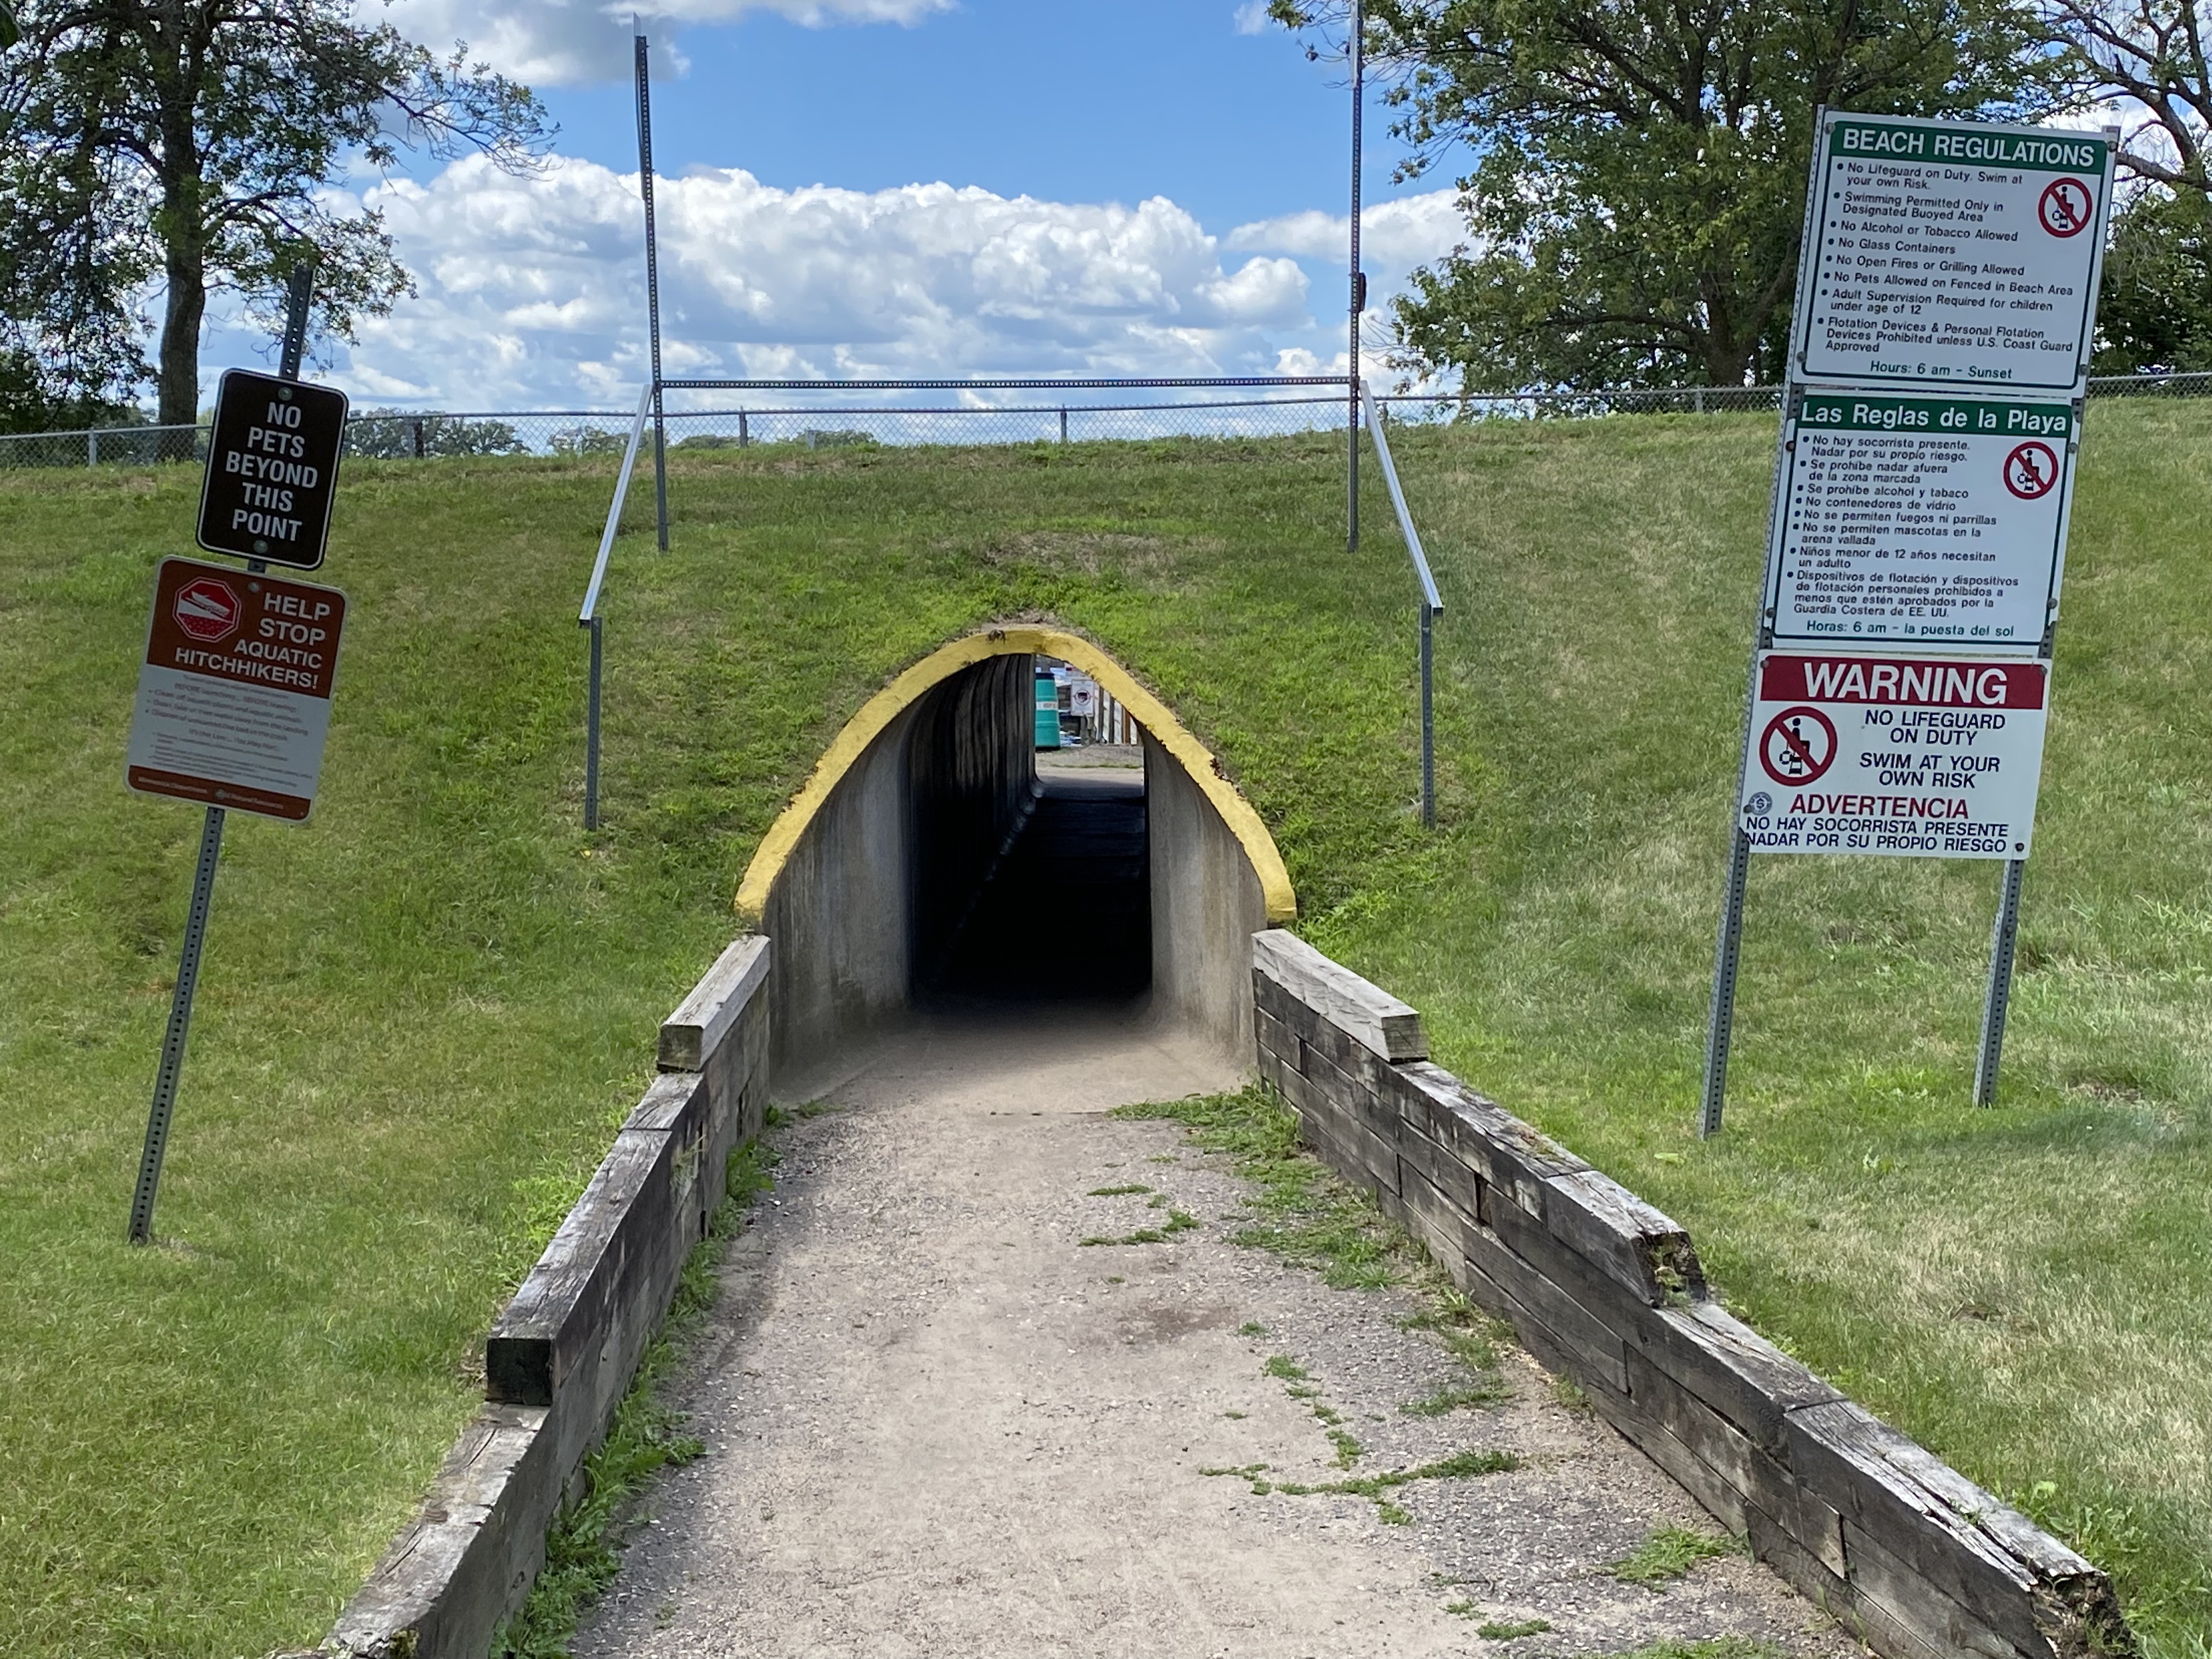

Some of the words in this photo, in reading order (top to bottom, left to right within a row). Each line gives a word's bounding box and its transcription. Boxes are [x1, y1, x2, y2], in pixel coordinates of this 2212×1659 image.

[1842, 128, 1925, 154] BEACH
[1933, 134, 2095, 167] REGULATIONS
[1846, 176, 1872, 187] your
[1876, 178, 1899, 188] own
[1847, 161, 1864, 173] No
[1867, 163, 1921, 178] Lifeguard
[1925, 170, 1940, 179] on
[1977, 171, 2007, 183] Swim
[2011, 174, 2023, 184] at
[1842, 202, 1908, 217] Designated
[1911, 207, 1954, 221] Buoyed
[1957, 210, 1983, 222] Area
[1844, 190, 1902, 207] Swimming
[1905, 195, 1961, 209] Permitted
[1963, 199, 1990, 213] Only
[1993, 201, 2004, 212] in
[1840, 219, 1857, 232] No
[1860, 221, 1903, 234] Alcohol
[1906, 226, 1920, 235] or
[1923, 224, 1971, 239] Tobacco
[1974, 228, 2018, 241] Allowed
[1837, 236, 1854, 249] No
[1858, 238, 1891, 251] Glass
[1894, 240, 1956, 255] Containers
[1835, 253, 1852, 266] No
[1856, 255, 1887, 268] Open
[1891, 257, 1918, 269] Fires
[1922, 262, 1936, 270] or
[1939, 259, 1978, 275] Grilling
[1980, 263, 2025, 276] Allowed
[1833, 270, 1850, 283] No
[1854, 272, 1880, 284] Pets
[1883, 274, 1928, 287] Allowed
[1931, 279, 1946, 288] on
[1950, 278, 1991, 291] Fenced
[1995, 280, 2005, 292] in
[2008, 281, 2044, 294] Beach
[2047, 284, 2073, 296] Area
[1830, 300, 1863, 312] under
[1866, 304, 1888, 315] age
[1892, 303, 1905, 314] of
[1910, 304, 1922, 315] 12
[1831, 287, 1862, 300] Adult
[1866, 289, 1932, 304] Supervision
[1936, 294, 1985, 308] Required
[1989, 297, 2006, 308] for
[2009, 298, 2053, 311] children
[1827, 315, 1877, 329] Flotation
[1881, 319, 1926, 332] Devices
[1931, 321, 1939, 333] &
[1944, 323, 1993, 336] Personal
[1995, 325, 2044, 338] Flotation
[1824, 339, 1880, 353] Approved
[1826, 327, 1871, 341] Devices
[1875, 330, 1933, 344] Prohibited
[1936, 335, 1972, 346] unless
[2002, 337, 2036, 350] Coast
[2039, 339, 2073, 352] Guard
[1869, 359, 1912, 374] Hours:
[1916, 362, 1926, 375] 6
[1931, 365, 1950, 376] am
[1967, 365, 2012, 379] Sunset
[266, 401, 301, 428] NO
[1801, 402, 1842, 423] Las
[1852, 403, 1929, 429] Reglas
[1939, 407, 1968, 427] de
[1977, 408, 1997, 428] la
[2007, 409, 2066, 435] Playa
[247, 426, 305, 458] PETS
[1812, 434, 1829, 445] No
[1832, 435, 1854, 448] hay
[1857, 437, 1914, 448] socorrista
[1810, 445, 1846, 457] Nadar
[1848, 449, 1869, 459] por
[1872, 450, 1886, 459] su
[225, 450, 318, 488] BEYOND
[1808, 470, 1823, 481] de
[1826, 470, 1837, 481] la
[1841, 473, 1869, 482] zona
[1872, 473, 1921, 484] marcada
[241, 481, 294, 512] THIS
[1807, 482, 1822, 494] Se
[1874, 485, 1915, 496] alcohol
[1918, 489, 1926, 499] y
[1930, 487, 1969, 499] tabaco
[1805, 495, 1821, 507] No
[1825, 497, 1902, 509] contenedores
[1906, 499, 1921, 510] de
[1926, 500, 1956, 511] vidrio
[232, 508, 303, 541] POINT
[1803, 509, 1820, 520] No
[1824, 511, 1838, 520] se
[1841, 511, 1891, 522] permiten
[1895, 511, 1934, 524] fuegos
[1938, 514, 1949, 523] ni
[1952, 514, 1996, 526] parrillas
[1801, 535, 1833, 544] arena
[1837, 534, 1876, 545] vallada
[1802, 521, 1818, 533] No
[1822, 524, 1836, 533] se
[1840, 523, 1889, 535] permiten
[1893, 526, 1949, 537] mascotas
[1953, 528, 1967, 537] en
[1971, 527, 1981, 538] la
[1815, 557, 1851, 569] adulto
[1835, 549, 1871, 558] menor
[1875, 548, 1889, 558] de
[1894, 548, 1906, 559] 12
[1941, 550, 1996, 562] necesitan
[263, 591, 330, 621] HELP
[258, 617, 326, 646] STOP
[1806, 619, 1848, 632] Horas:
[1852, 620, 1862, 633] 6
[1866, 623, 1887, 633] am
[1904, 622, 1915, 634] la
[1920, 624, 1965, 636] puesta
[1970, 624, 1990, 636] del
[1995, 625, 2015, 637] sol
[233, 639, 323, 669] AQUATIC
[174, 647, 318, 690] HITCHHIKERS!
[1803, 662, 2007, 705] WARNING
[1864, 709, 1893, 726] NO
[1900, 710, 2006, 730] LIFEGUARD
[1889, 727, 1918, 744] ON
[1925, 729, 1978, 746] DUTY
[1859, 752, 1912, 769] SWIM
[1918, 754, 1943, 770] AT
[1949, 755, 2000, 772] YOUR
[1878, 770, 1925, 787] OWN
[1931, 771, 1977, 789] RISK
[1788, 793, 1969, 820] ADVERTENCIA
[1746, 816, 1770, 830] NO
[1776, 816, 1807, 831] HAY
[1813, 817, 1917, 834] SOCORRISTA
[1923, 821, 2009, 837] PRESENTE
[1745, 832, 1799, 846] NADAR
[1805, 832, 1839, 847] POR
[1846, 833, 1870, 848] SU
[1876, 834, 1938, 850] PROPIO
[1943, 837, 2007, 853] RIESGO
